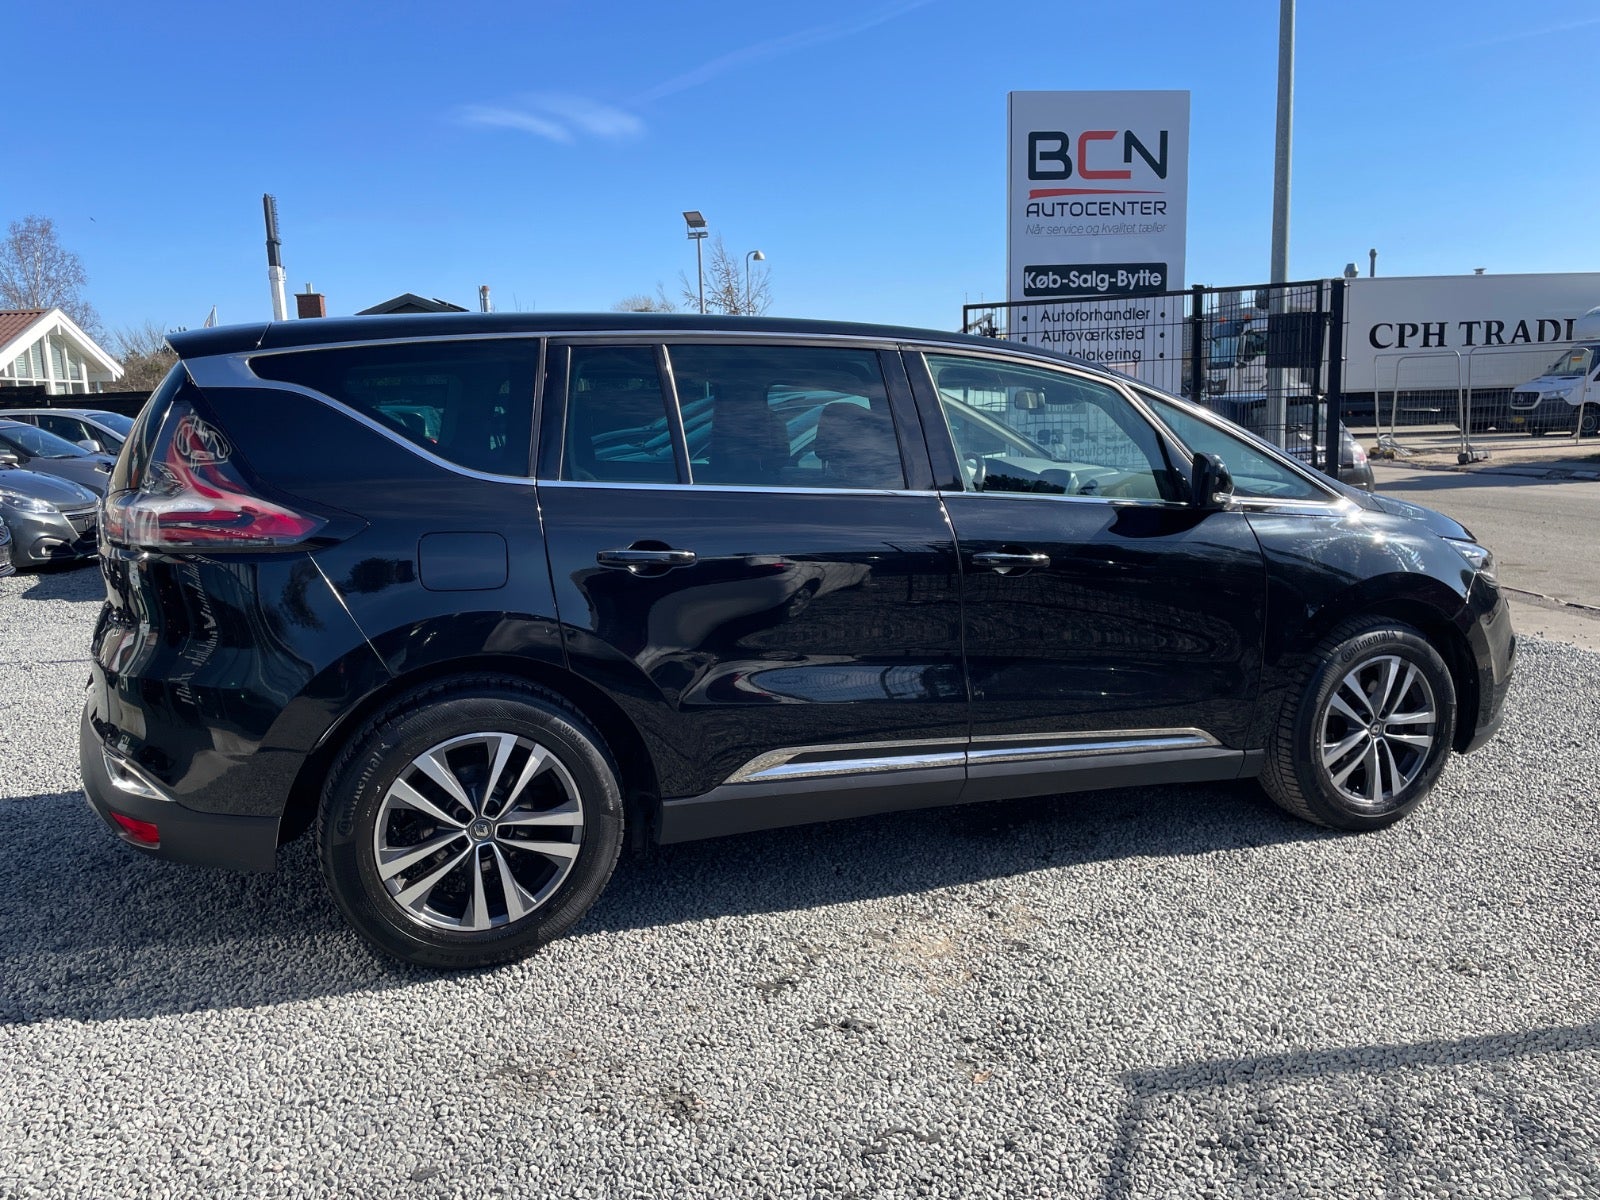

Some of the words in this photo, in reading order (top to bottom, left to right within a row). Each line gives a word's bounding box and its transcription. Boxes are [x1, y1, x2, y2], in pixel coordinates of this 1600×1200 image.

[1028, 130, 1168, 180] BCN
[1026, 201, 1167, 217] AUTOCENTER
[1025, 224, 1046, 236] Når
[1047, 224, 1084, 235] service
[1086, 226, 1100, 237] og
[1101, 223, 1136, 234] kvalitet
[1024, 270, 1162, 291] Køb-Salg-Bytte
[1040, 308, 1150, 323] Autoforhandler
[1041, 328, 1145, 343] Autoværksted
[1368, 321, 1448, 349] CPH
[1068, 349, 1141, 362] tolakering
[1341, 630, 1391, 663] Continental
